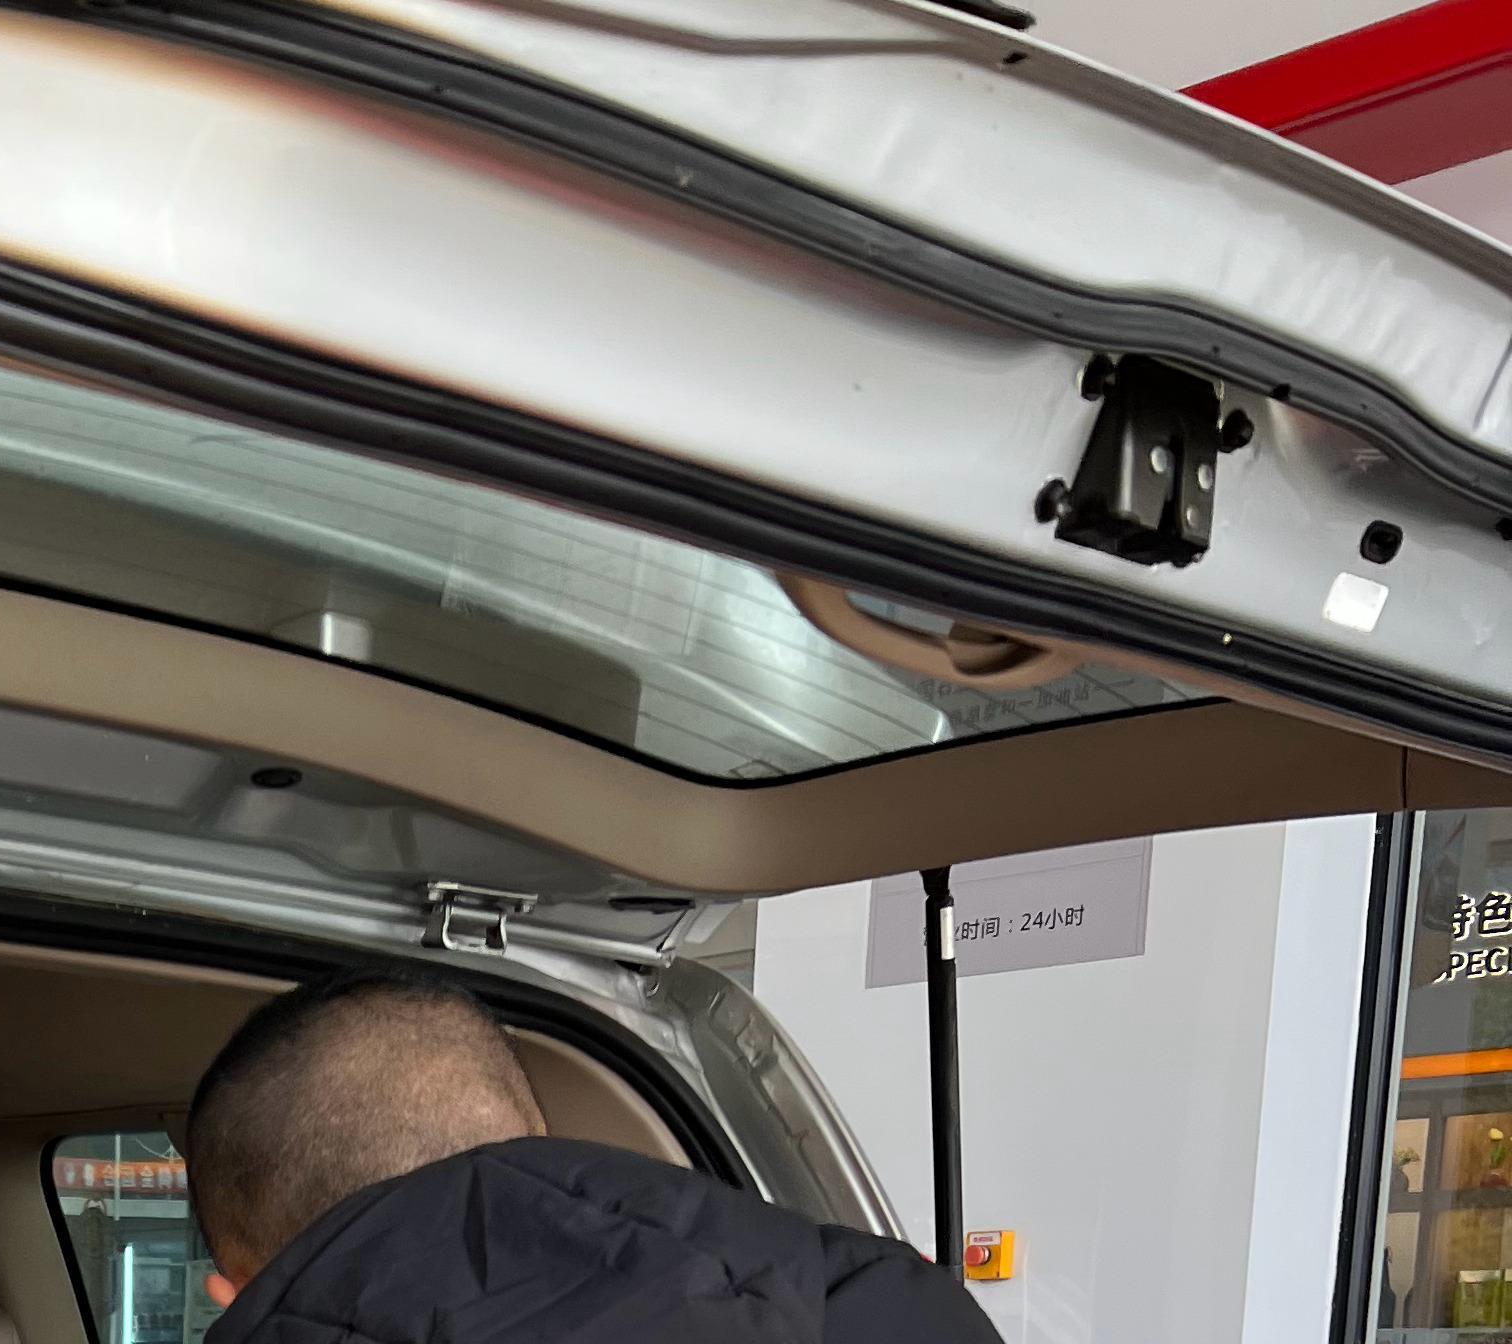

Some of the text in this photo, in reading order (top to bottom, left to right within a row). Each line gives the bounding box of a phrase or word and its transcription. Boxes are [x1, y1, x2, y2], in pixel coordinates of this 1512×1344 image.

[924, 904, 1084, 947] 时间：24小时
[1432, 947, 1512, 984] PEC
